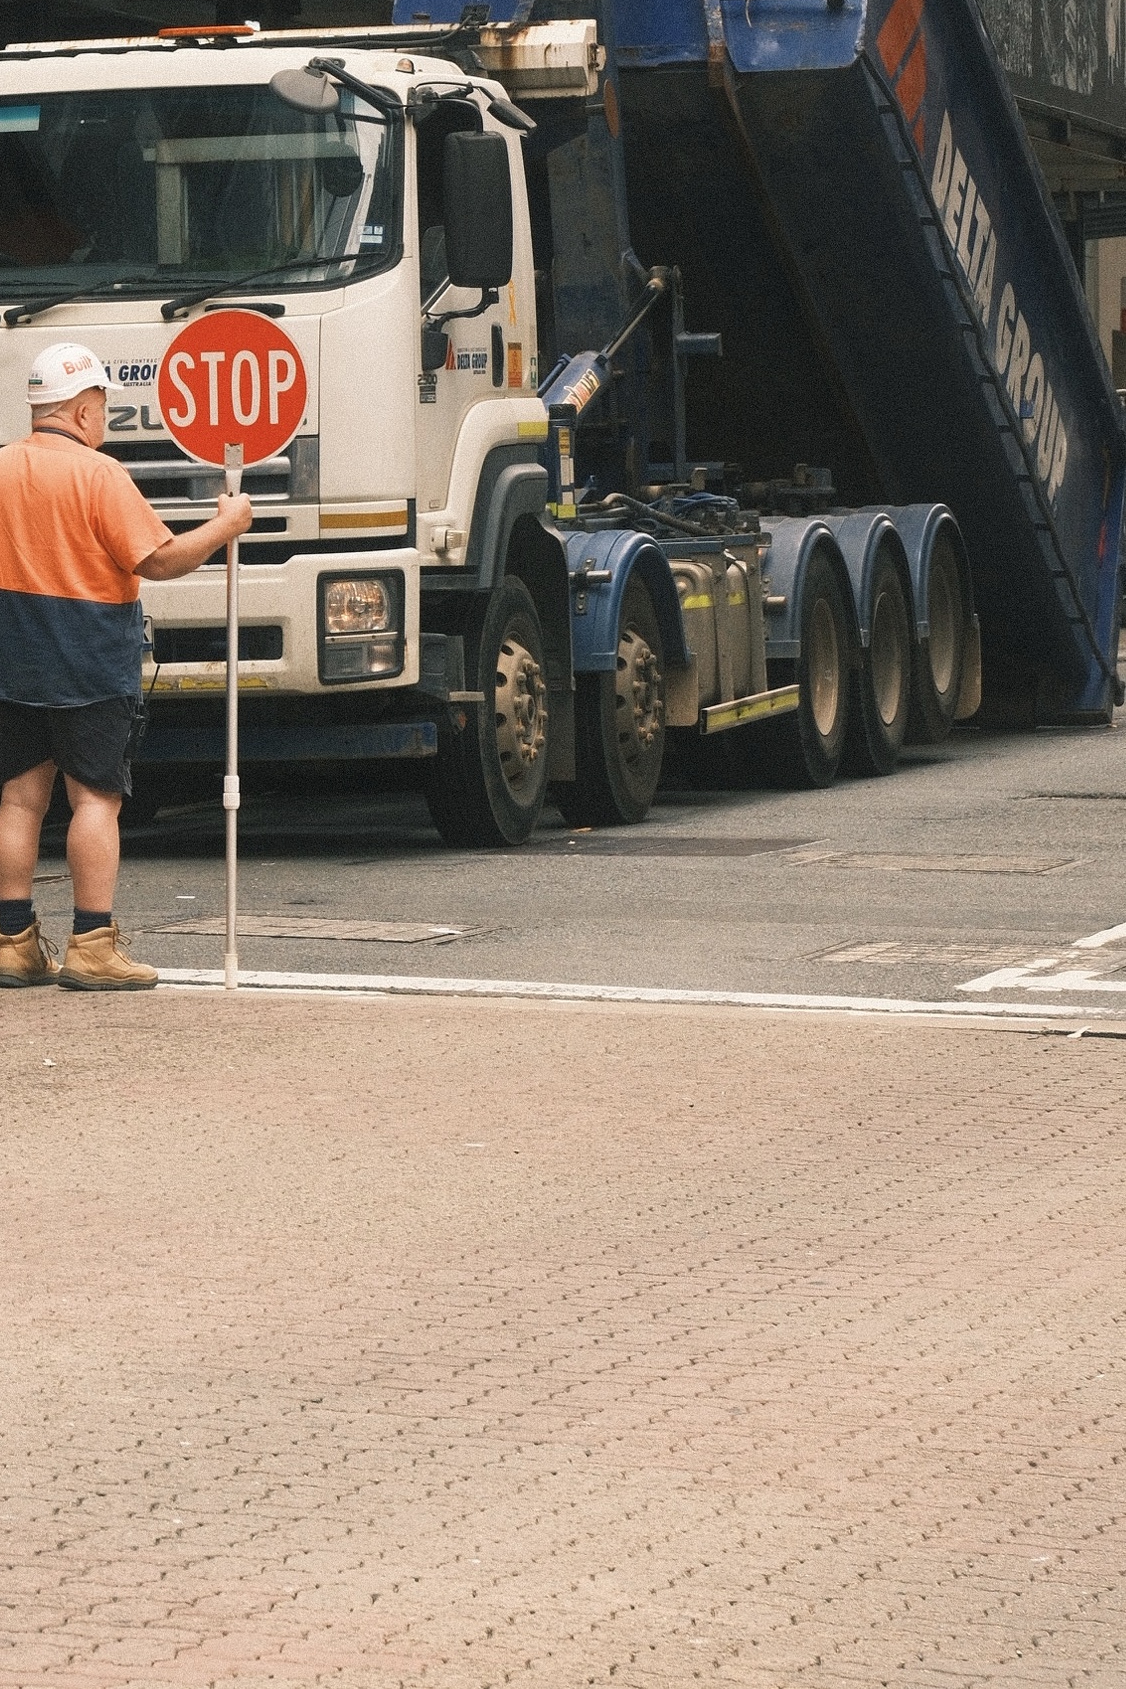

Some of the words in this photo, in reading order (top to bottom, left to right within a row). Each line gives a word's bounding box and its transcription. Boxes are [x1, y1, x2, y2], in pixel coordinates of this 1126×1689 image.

[931, 109, 997, 329] DELTA
[995, 281, 1067, 504] GROUP
[63, 355, 93, 375] Built
[168, 349, 297, 428] STOP
